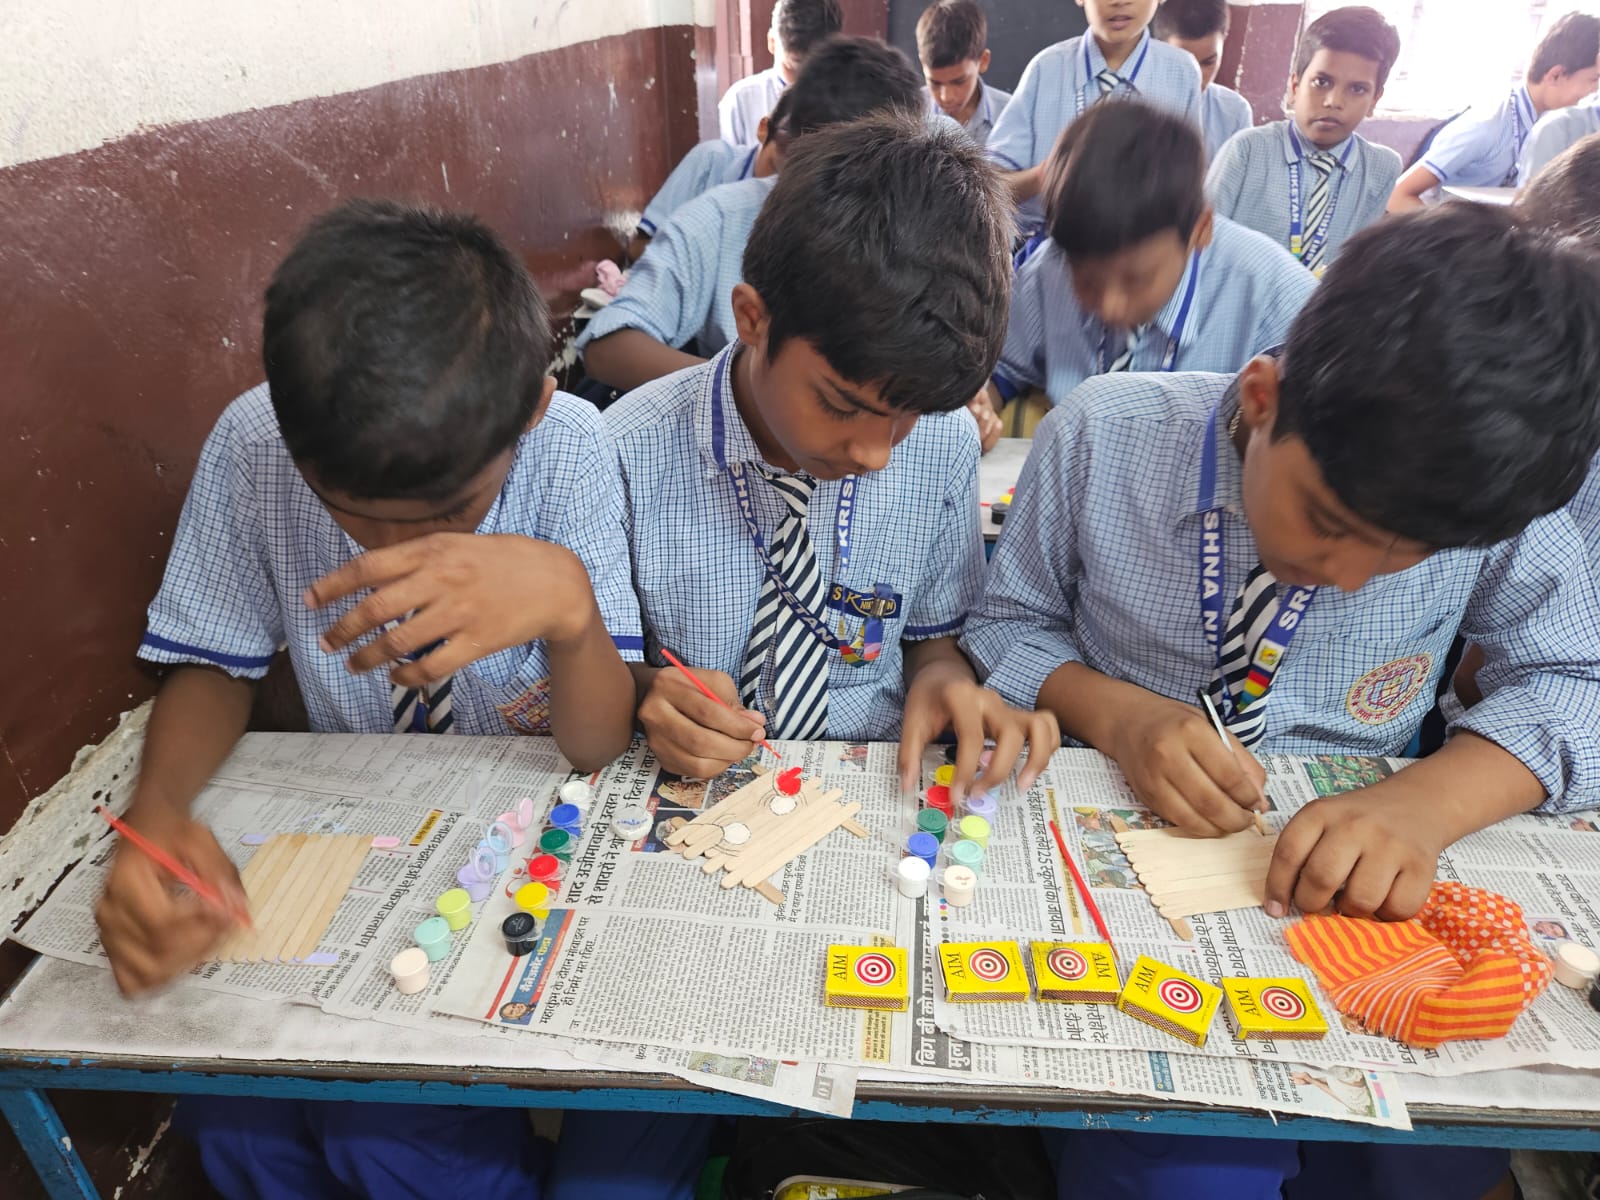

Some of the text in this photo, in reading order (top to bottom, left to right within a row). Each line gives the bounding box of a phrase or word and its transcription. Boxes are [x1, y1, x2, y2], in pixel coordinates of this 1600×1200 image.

[731, 462, 834, 644] SHNA NIKETAN
[1202, 511, 1221, 600] SHNA
[634, 767, 649, 777] से
[624, 776, 647, 801] दिलों
[565, 878, 585, 904] शाद
[615, 752, 633, 771] और
[1037, 849, 1052, 864] 25
[590, 859, 615, 891] शायरों
[381, 889, 409, 911] किया
[583, 890, 604, 906] से
[1045, 889, 1058, 902] का
[1047, 903, 1065, 934] जायजा
[551, 978, 564, 991] के
[578, 915, 590, 926] पर
[946, 952, 965, 979] AIM
[1092, 952, 1112, 978] AIM
[832, 954, 847, 980] AIM
[1135, 966, 1155, 993] AIM
[915, 995, 934, 1014] को
[1235, 989, 1261, 1016] AIM
[915, 1017, 936, 1034] बी
[915, 1036, 936, 1065] बिग
